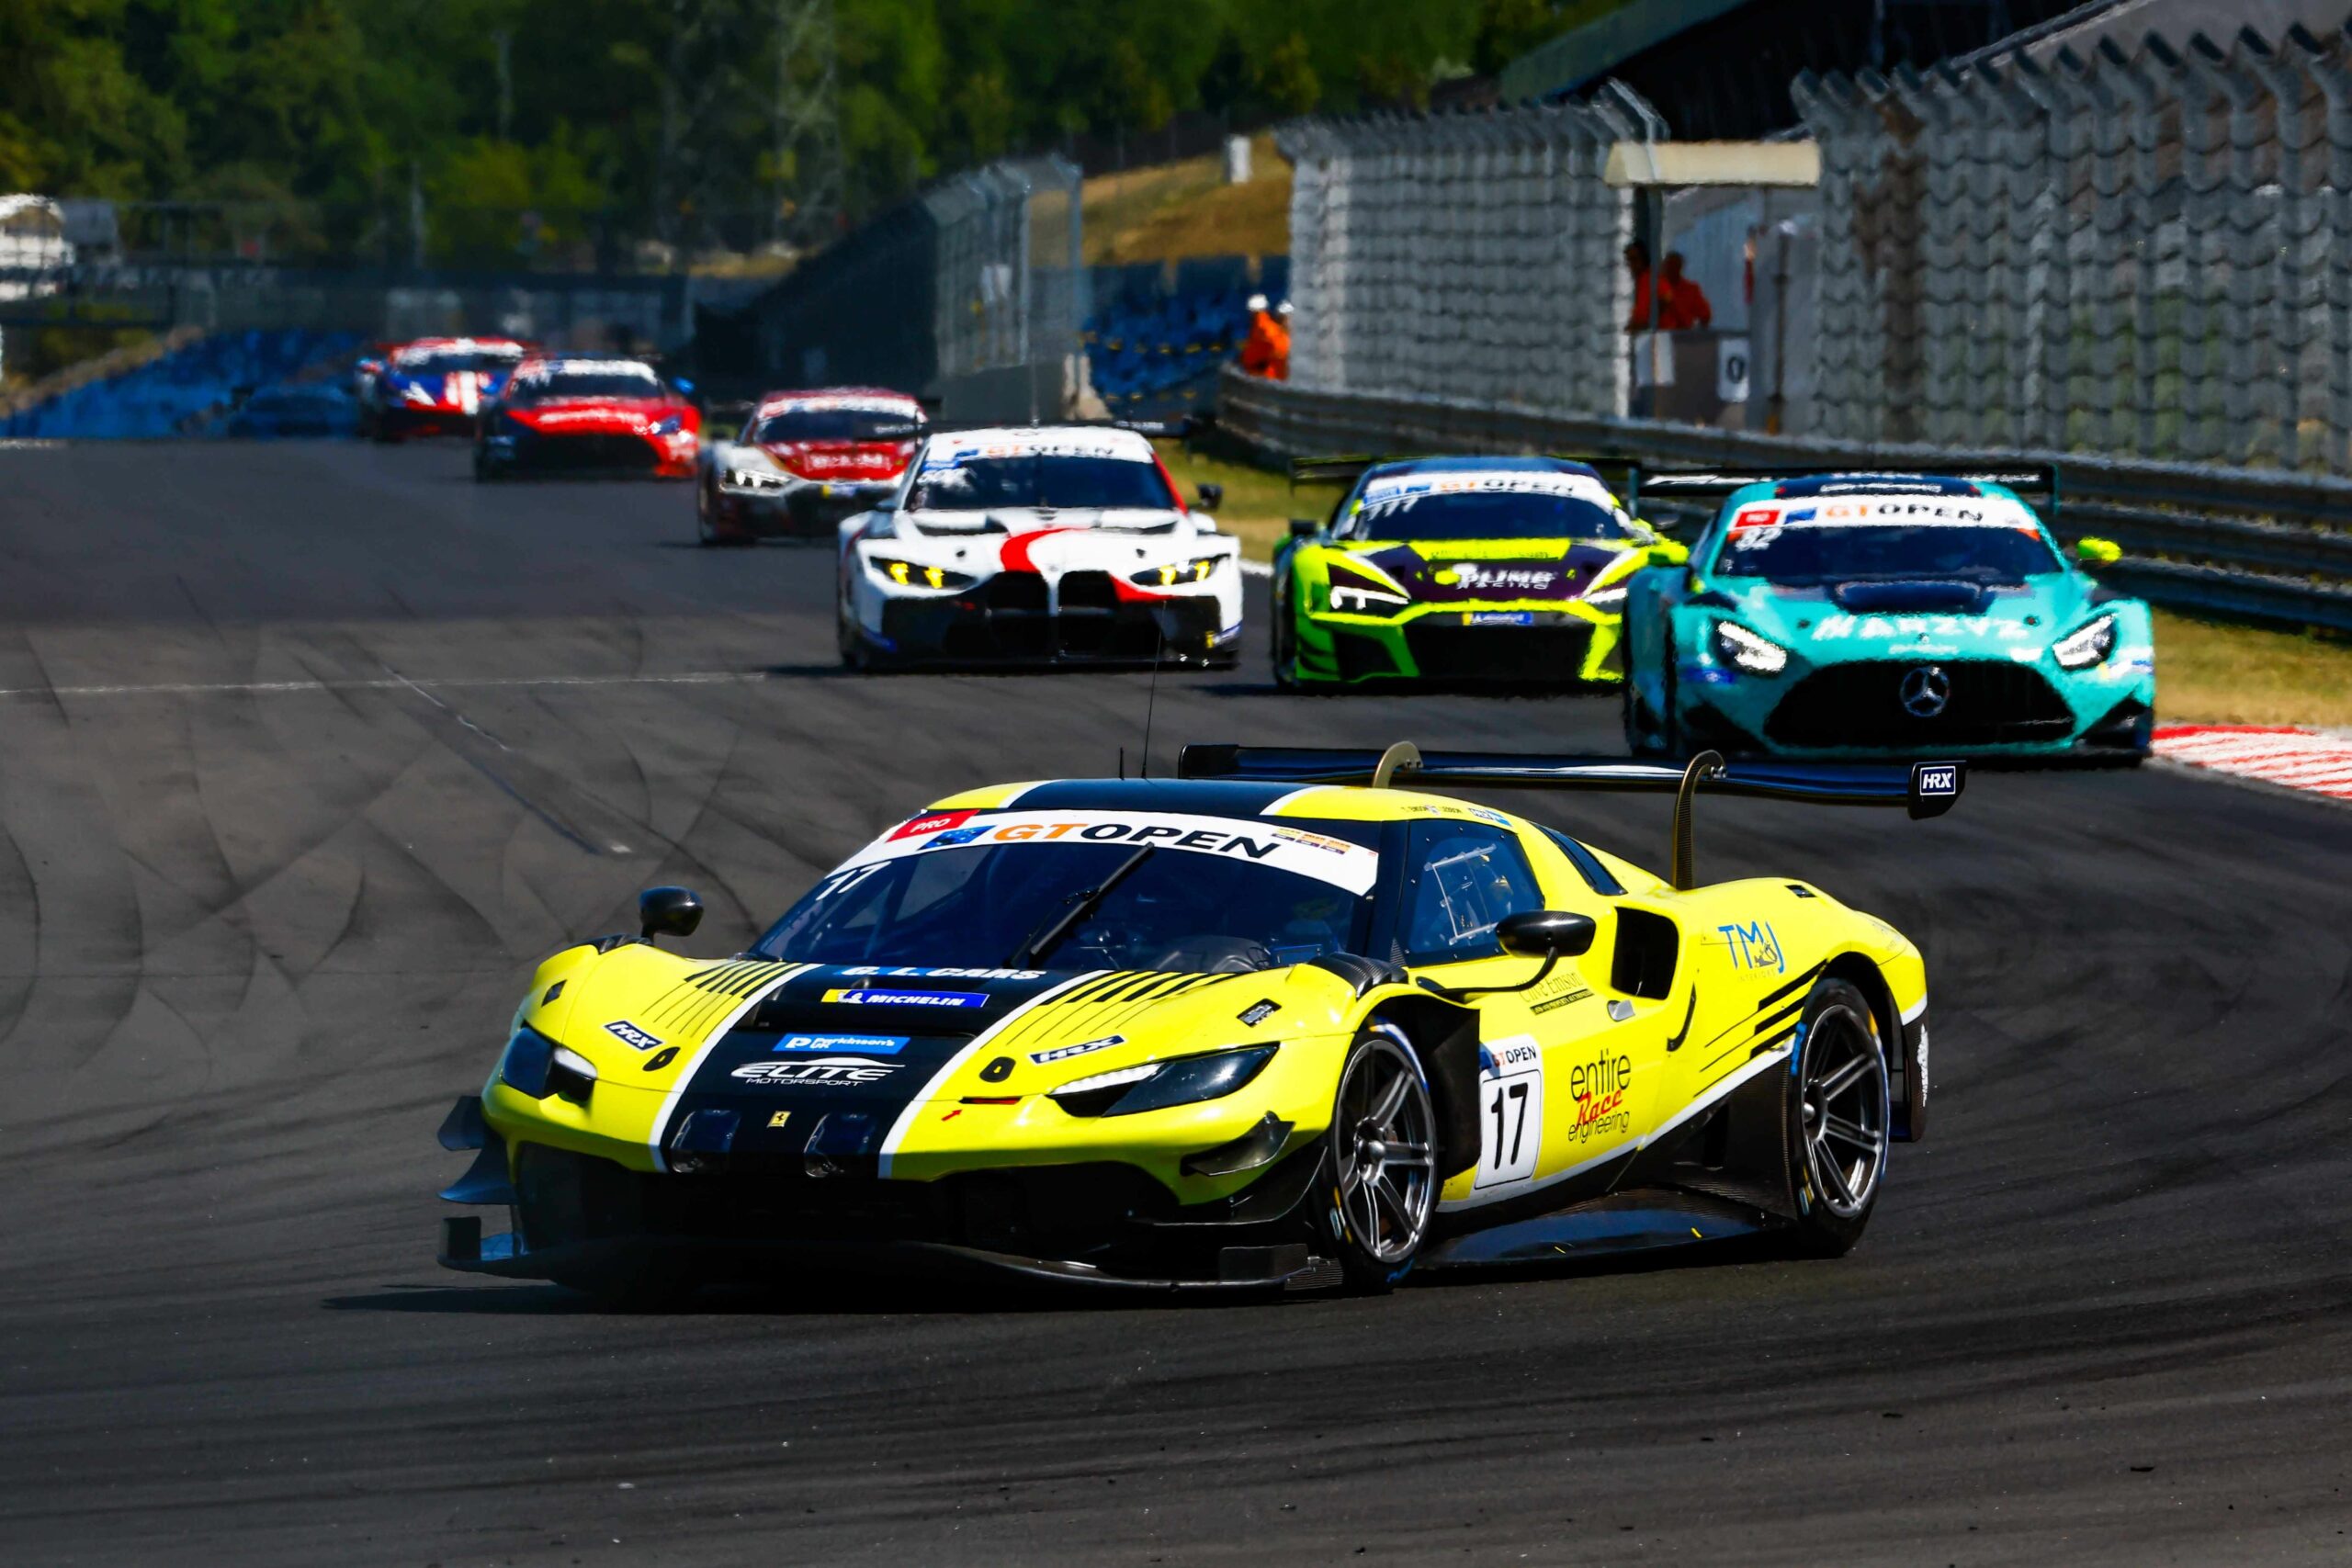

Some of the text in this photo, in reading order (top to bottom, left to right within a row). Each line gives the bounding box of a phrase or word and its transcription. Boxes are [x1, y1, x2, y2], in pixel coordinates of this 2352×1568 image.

[1825, 503, 1984, 522] GTOPEN
[1923, 773, 1952, 789] HRX
[910, 818, 952, 833] PRO
[993, 823, 1281, 860] GTOPEN
[816, 861, 892, 900] 17
[1717, 921, 1785, 974] TMJ
[893, 966, 921, 976] L.
[925, 968, 1047, 980] CARS
[866, 994, 966, 1006] MICHELIN
[608, 1023, 658, 1048] HRX
[814, 1037, 896, 1047] Parkinson's
[1039, 1037, 1114, 1062] HRX
[730, 1066, 894, 1081] ELITE
[746, 1077, 864, 1087] MOTORSPORT
[1571, 1048, 1631, 1101] entire
[1491, 1082, 1528, 1170] 17
[1567, 1110, 1630, 1144] engineering
